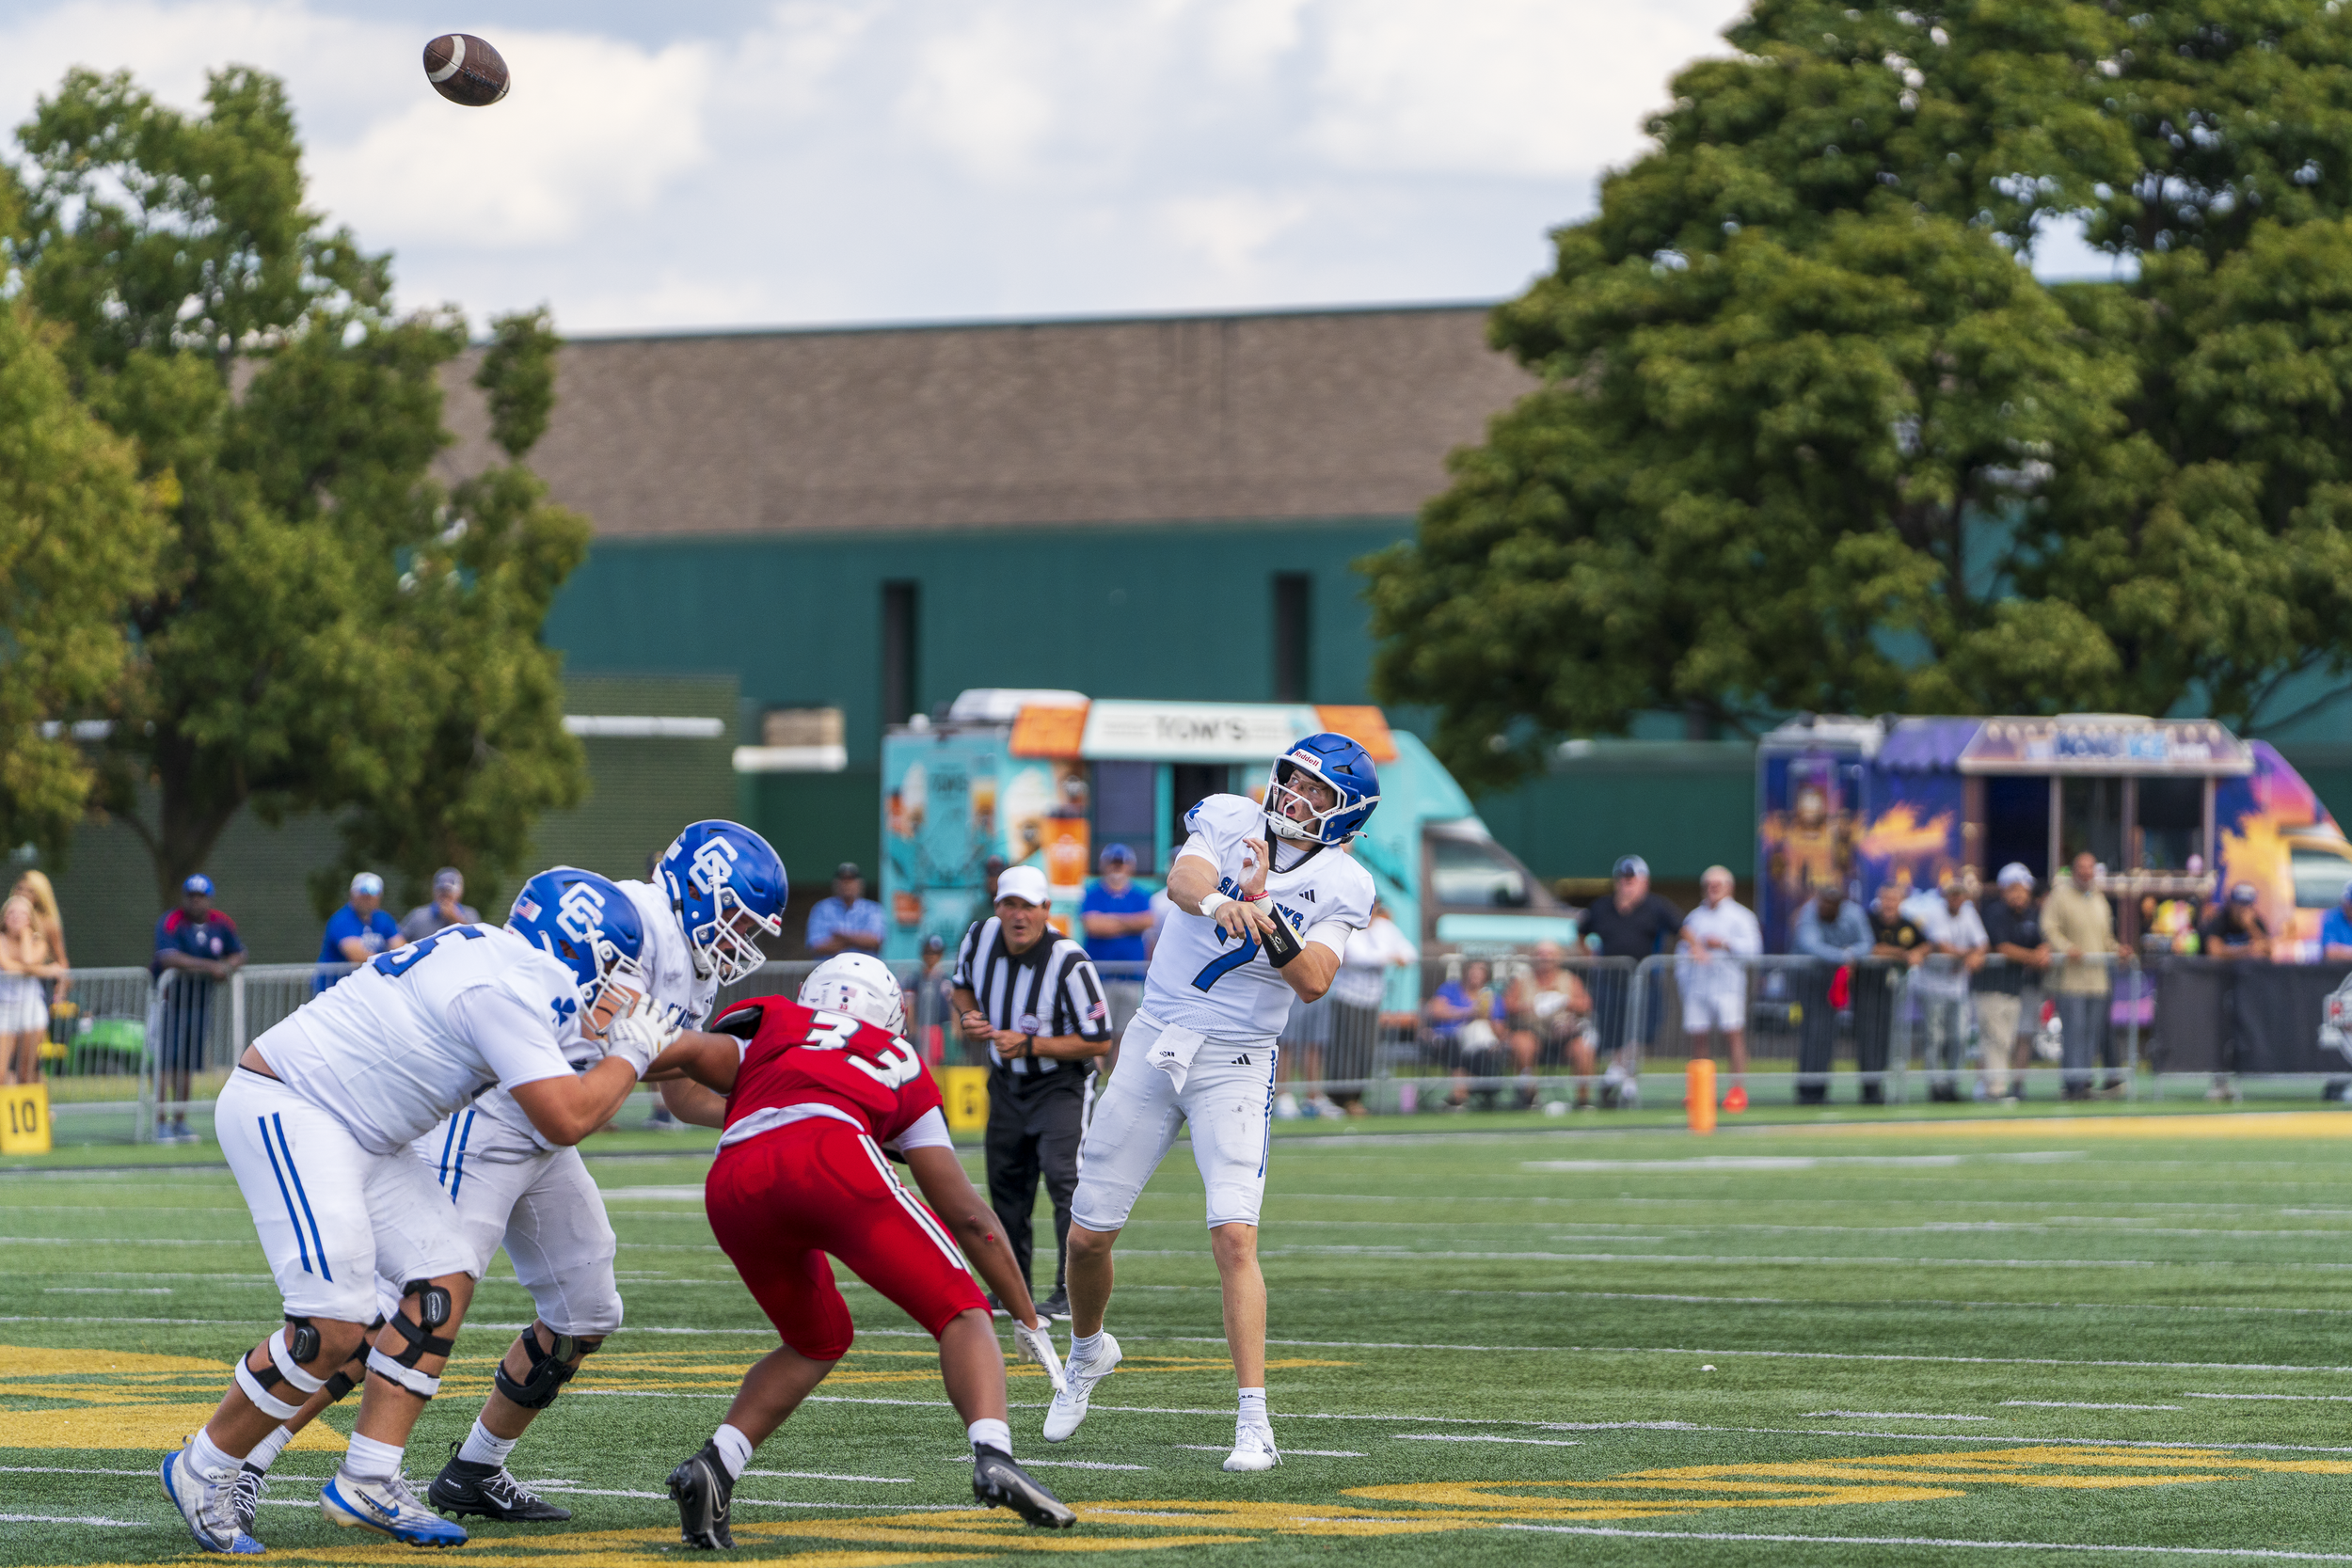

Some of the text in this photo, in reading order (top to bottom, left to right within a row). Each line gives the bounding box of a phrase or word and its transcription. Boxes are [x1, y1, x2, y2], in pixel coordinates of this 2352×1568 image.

[1295, 751, 1319, 767] Riddell
[1190, 923, 1263, 993] 7
[838, 1003, 849, 1011] 33
[800, 1009, 923, 1092] 33
[8, 1098, 37, 1134] 10
